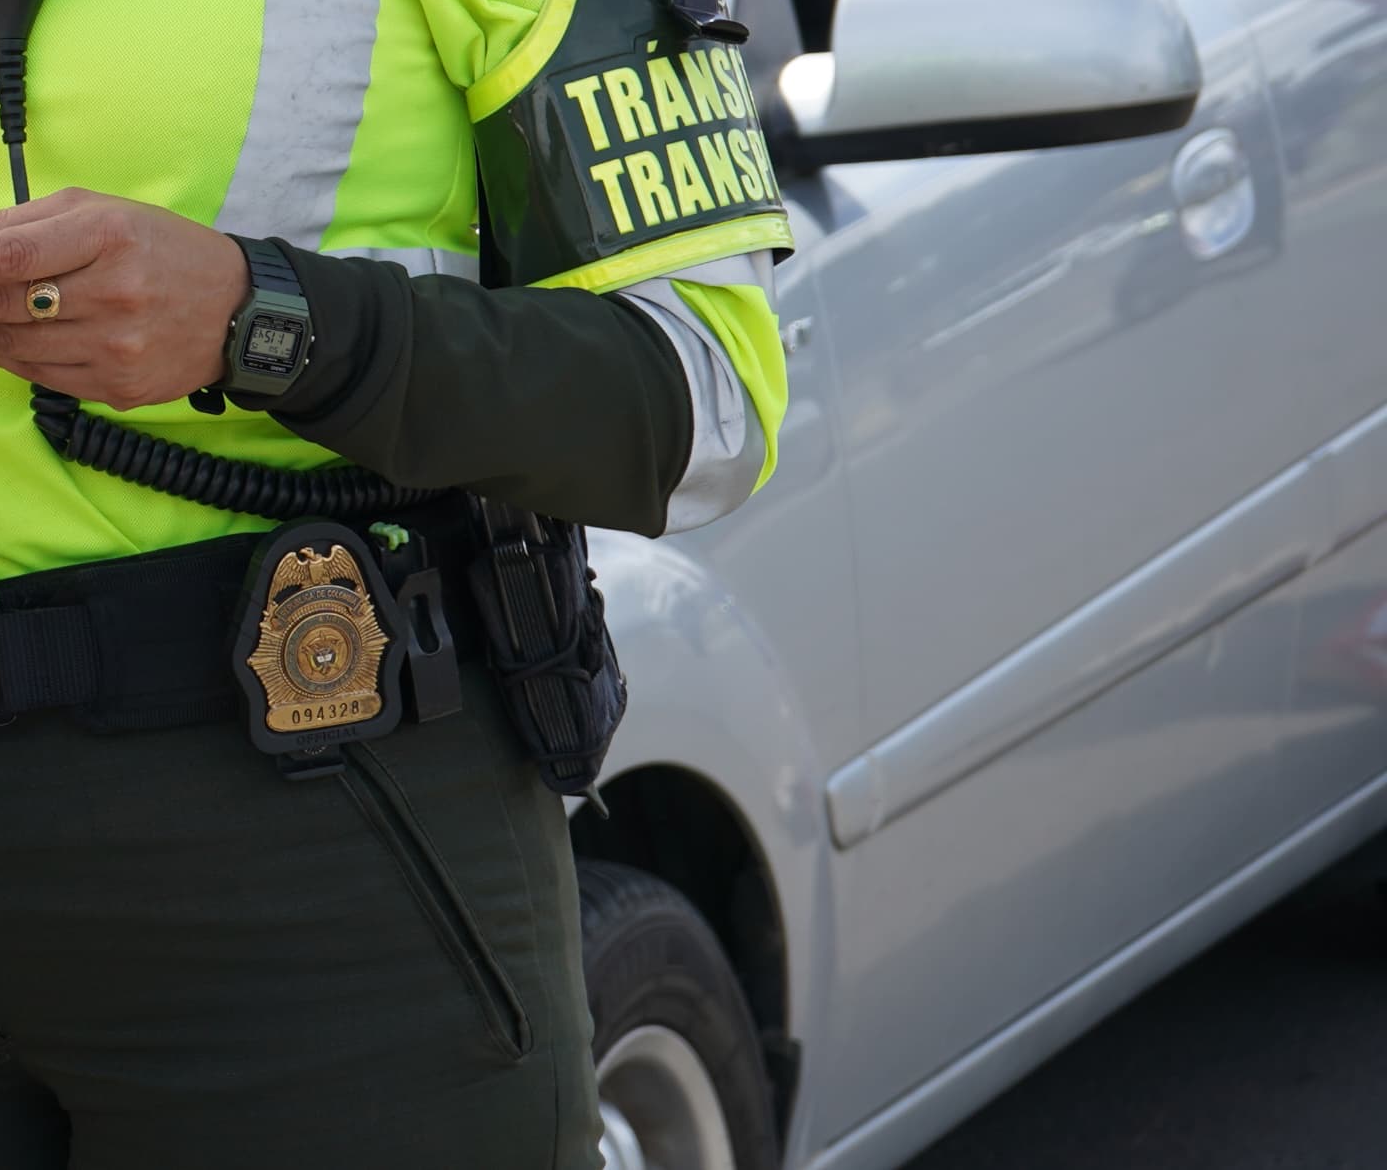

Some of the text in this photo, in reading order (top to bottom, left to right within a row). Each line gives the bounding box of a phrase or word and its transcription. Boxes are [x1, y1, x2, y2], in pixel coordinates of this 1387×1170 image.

[564, 38, 755, 151] TRÁNSI
[590, 128, 779, 235] TRANSP
[291, 700, 360, 725] 094328
